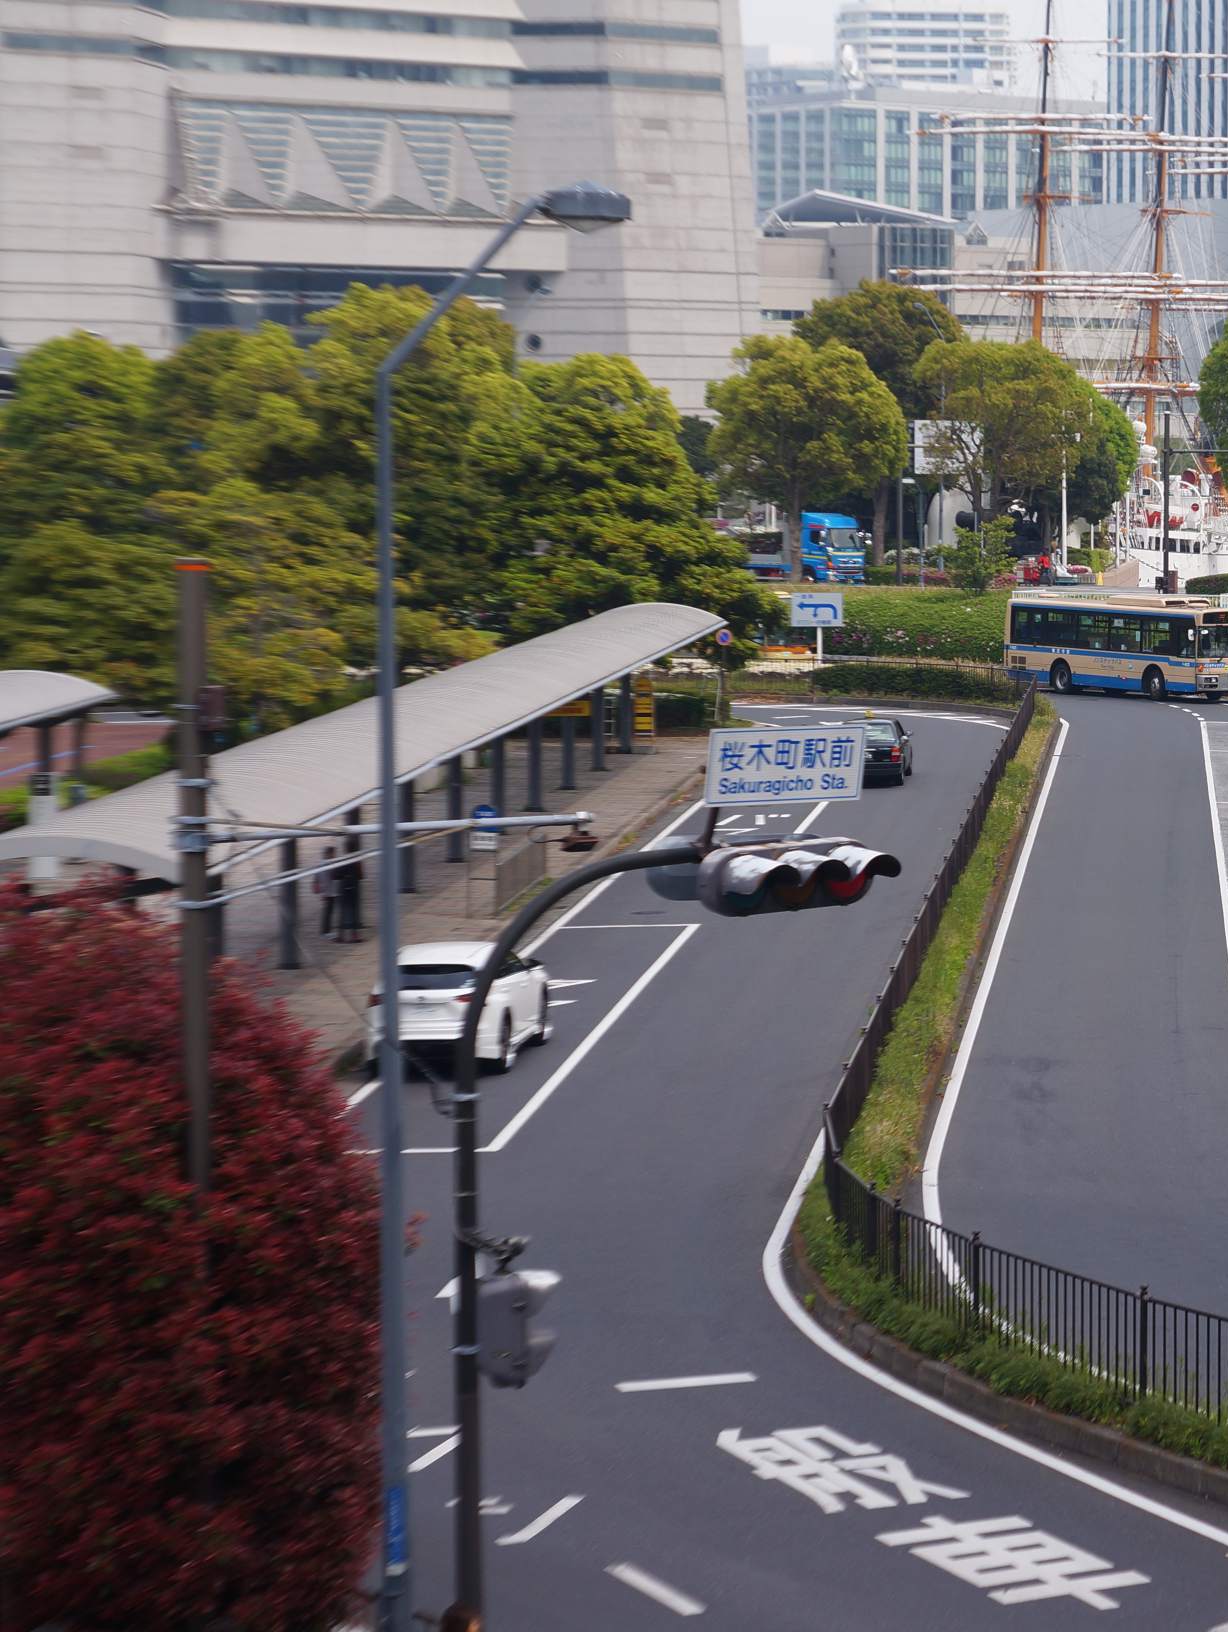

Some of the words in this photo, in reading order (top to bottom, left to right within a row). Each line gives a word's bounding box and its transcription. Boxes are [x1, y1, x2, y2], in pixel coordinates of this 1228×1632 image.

[719, 735, 855, 772] 桜木町駅前
[719, 775, 814, 796] Sakuragicho
[820, 773, 848, 790] Sta.
